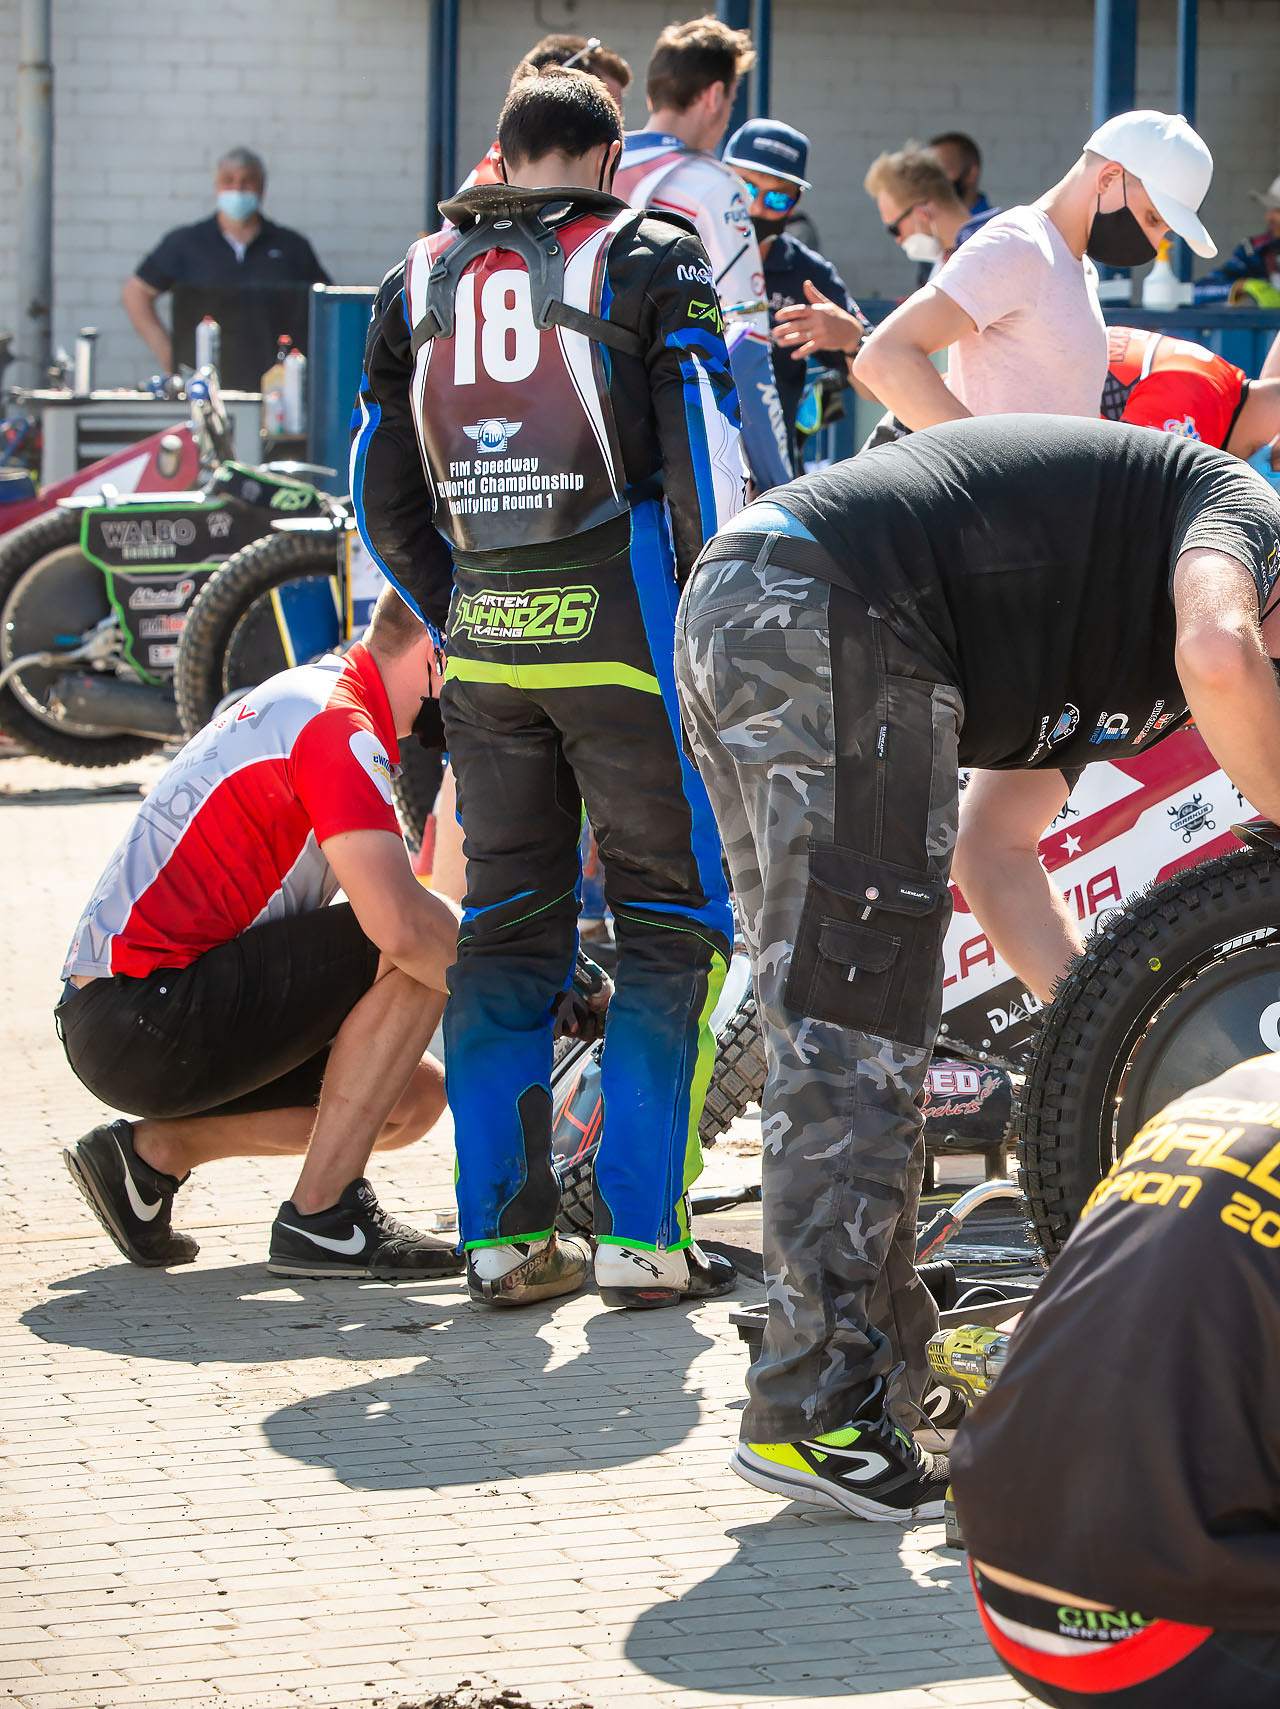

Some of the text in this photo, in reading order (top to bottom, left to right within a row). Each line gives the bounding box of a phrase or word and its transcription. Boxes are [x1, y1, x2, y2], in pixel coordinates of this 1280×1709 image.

[454, 269, 541, 386] 18
[482, 431, 504, 443] FIM
[449, 457, 539, 477] FIM Speedway
[480, 472, 584, 493] Championship
[502, 494, 543, 511] Round
[545, 493, 553, 509] 1
[473, 594, 530, 608] ARTEM
[522, 591, 594, 638] 26
[473, 624, 524, 638] RACING
[1174, 804, 1210, 829] MARKUS
